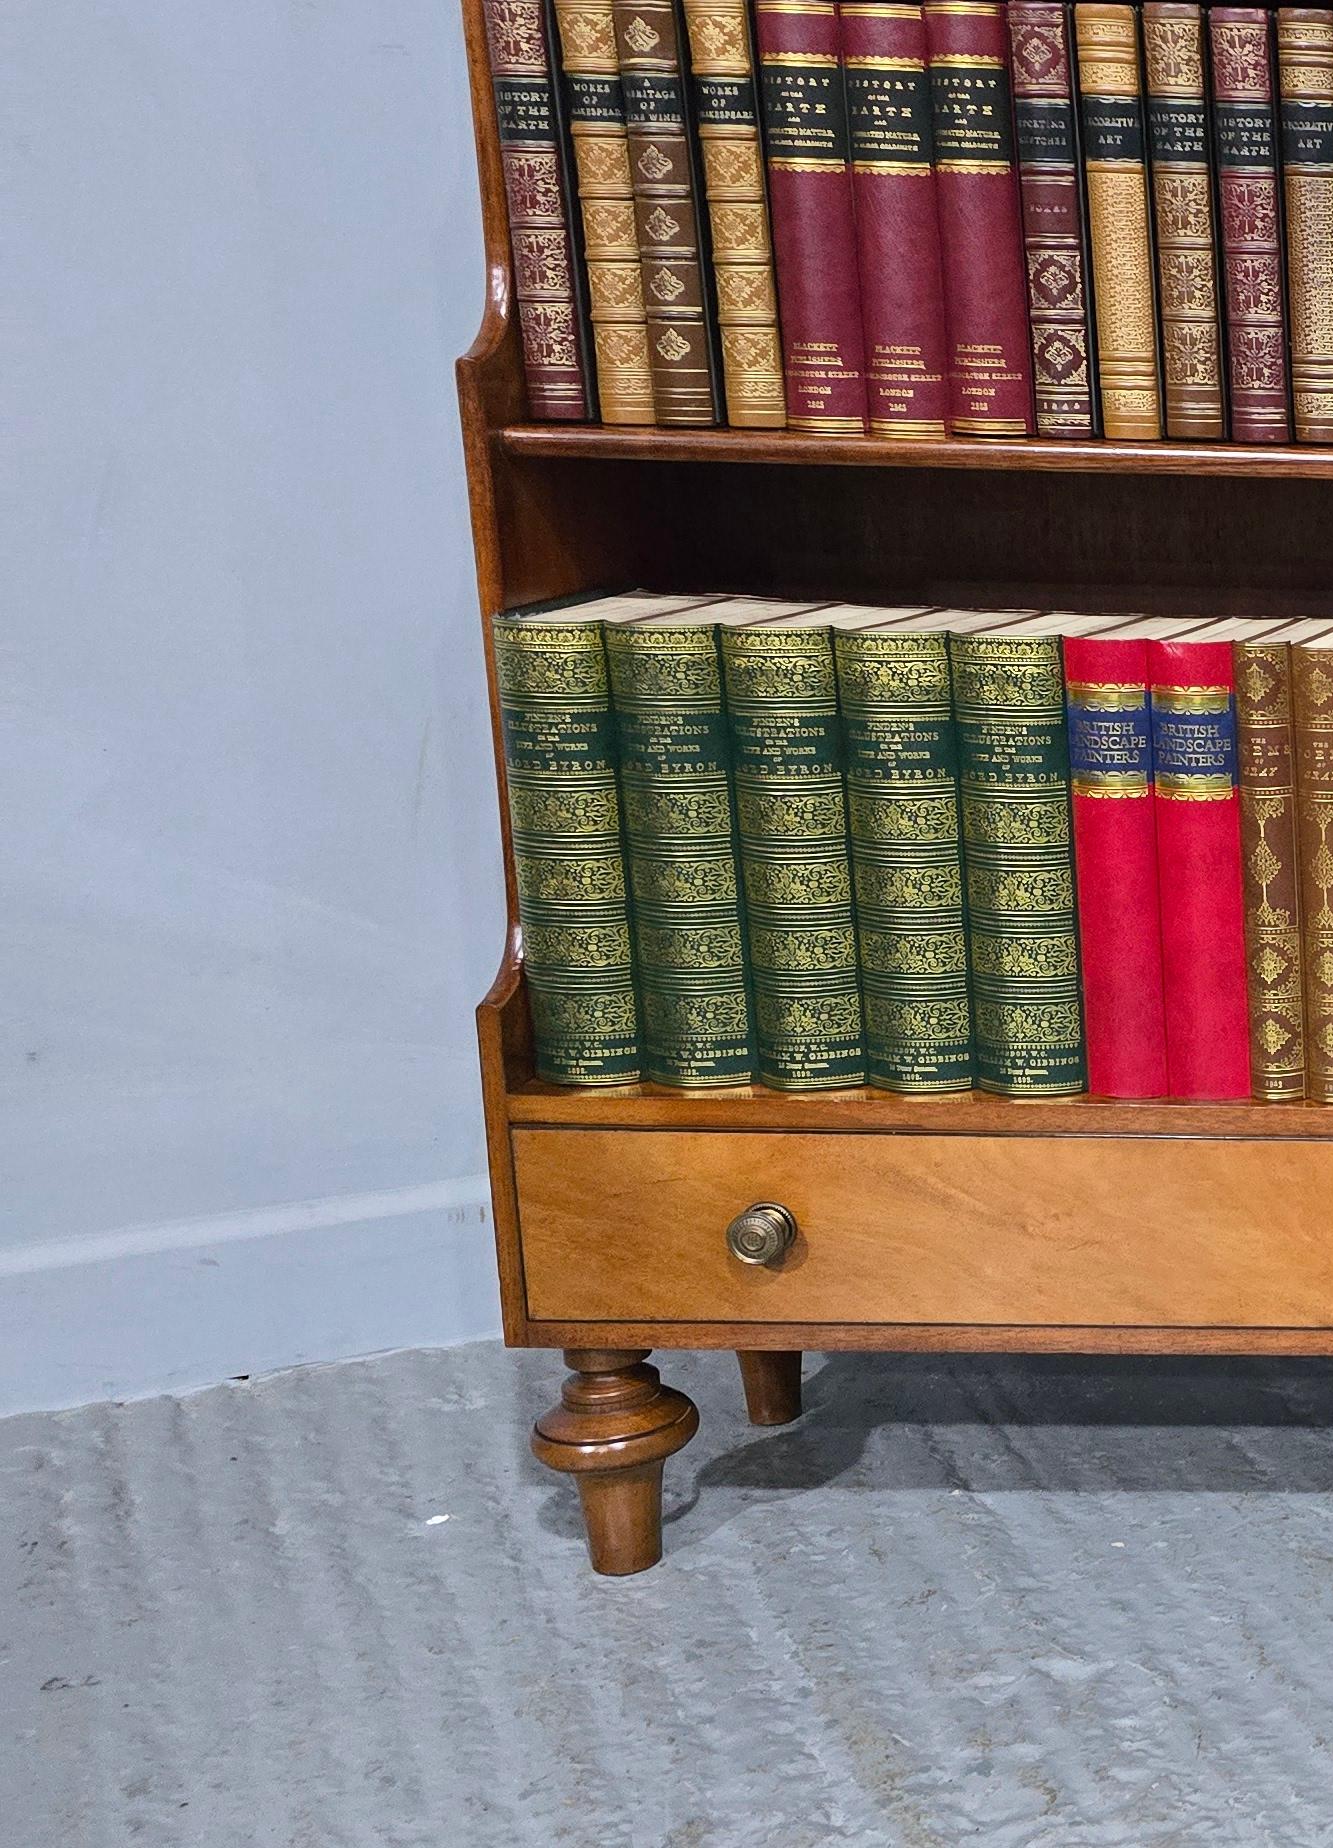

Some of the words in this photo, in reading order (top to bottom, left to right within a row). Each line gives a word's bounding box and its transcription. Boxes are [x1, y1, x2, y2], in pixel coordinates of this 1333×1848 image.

[573, 82, 610, 93] WORKS
[701, 86, 739, 96] WORKS
[583, 95, 598, 105] OF
[712, 98, 727, 108] OF
[517, 105, 550, 116] THE
[1174, 127, 1204, 138] THE
[1241, 131, 1271, 142] THE
[1098, 135, 1123, 145] ART
[1298, 139, 1323, 149] ART
[1076, 721, 1135, 735] BRITISH
[1161, 723, 1220, 738] BRITISH
[1072, 735, 1147, 749] LANDSCAPE
[1153, 737, 1231, 751] LANDSCAPE
[669, 744, 701, 753] WORKS
[785, 746, 817, 755] WORKS
[899, 751, 931, 760] WORKS
[1074, 750, 1140, 764] PAINTERS
[1159, 753, 1225, 767] PAINTERS
[661, 761, 717, 773] BYRON
[776, 763, 833, 775] BYRON
[890, 768, 947, 779] BYRON
[583, 1046, 637, 1058] GIBBINGS
[809, 1047, 861, 1060] GIBBINGS
[917, 1053, 970, 1064] GIBBINGS
[1029, 1056, 1080, 1067] GIBBINGS
